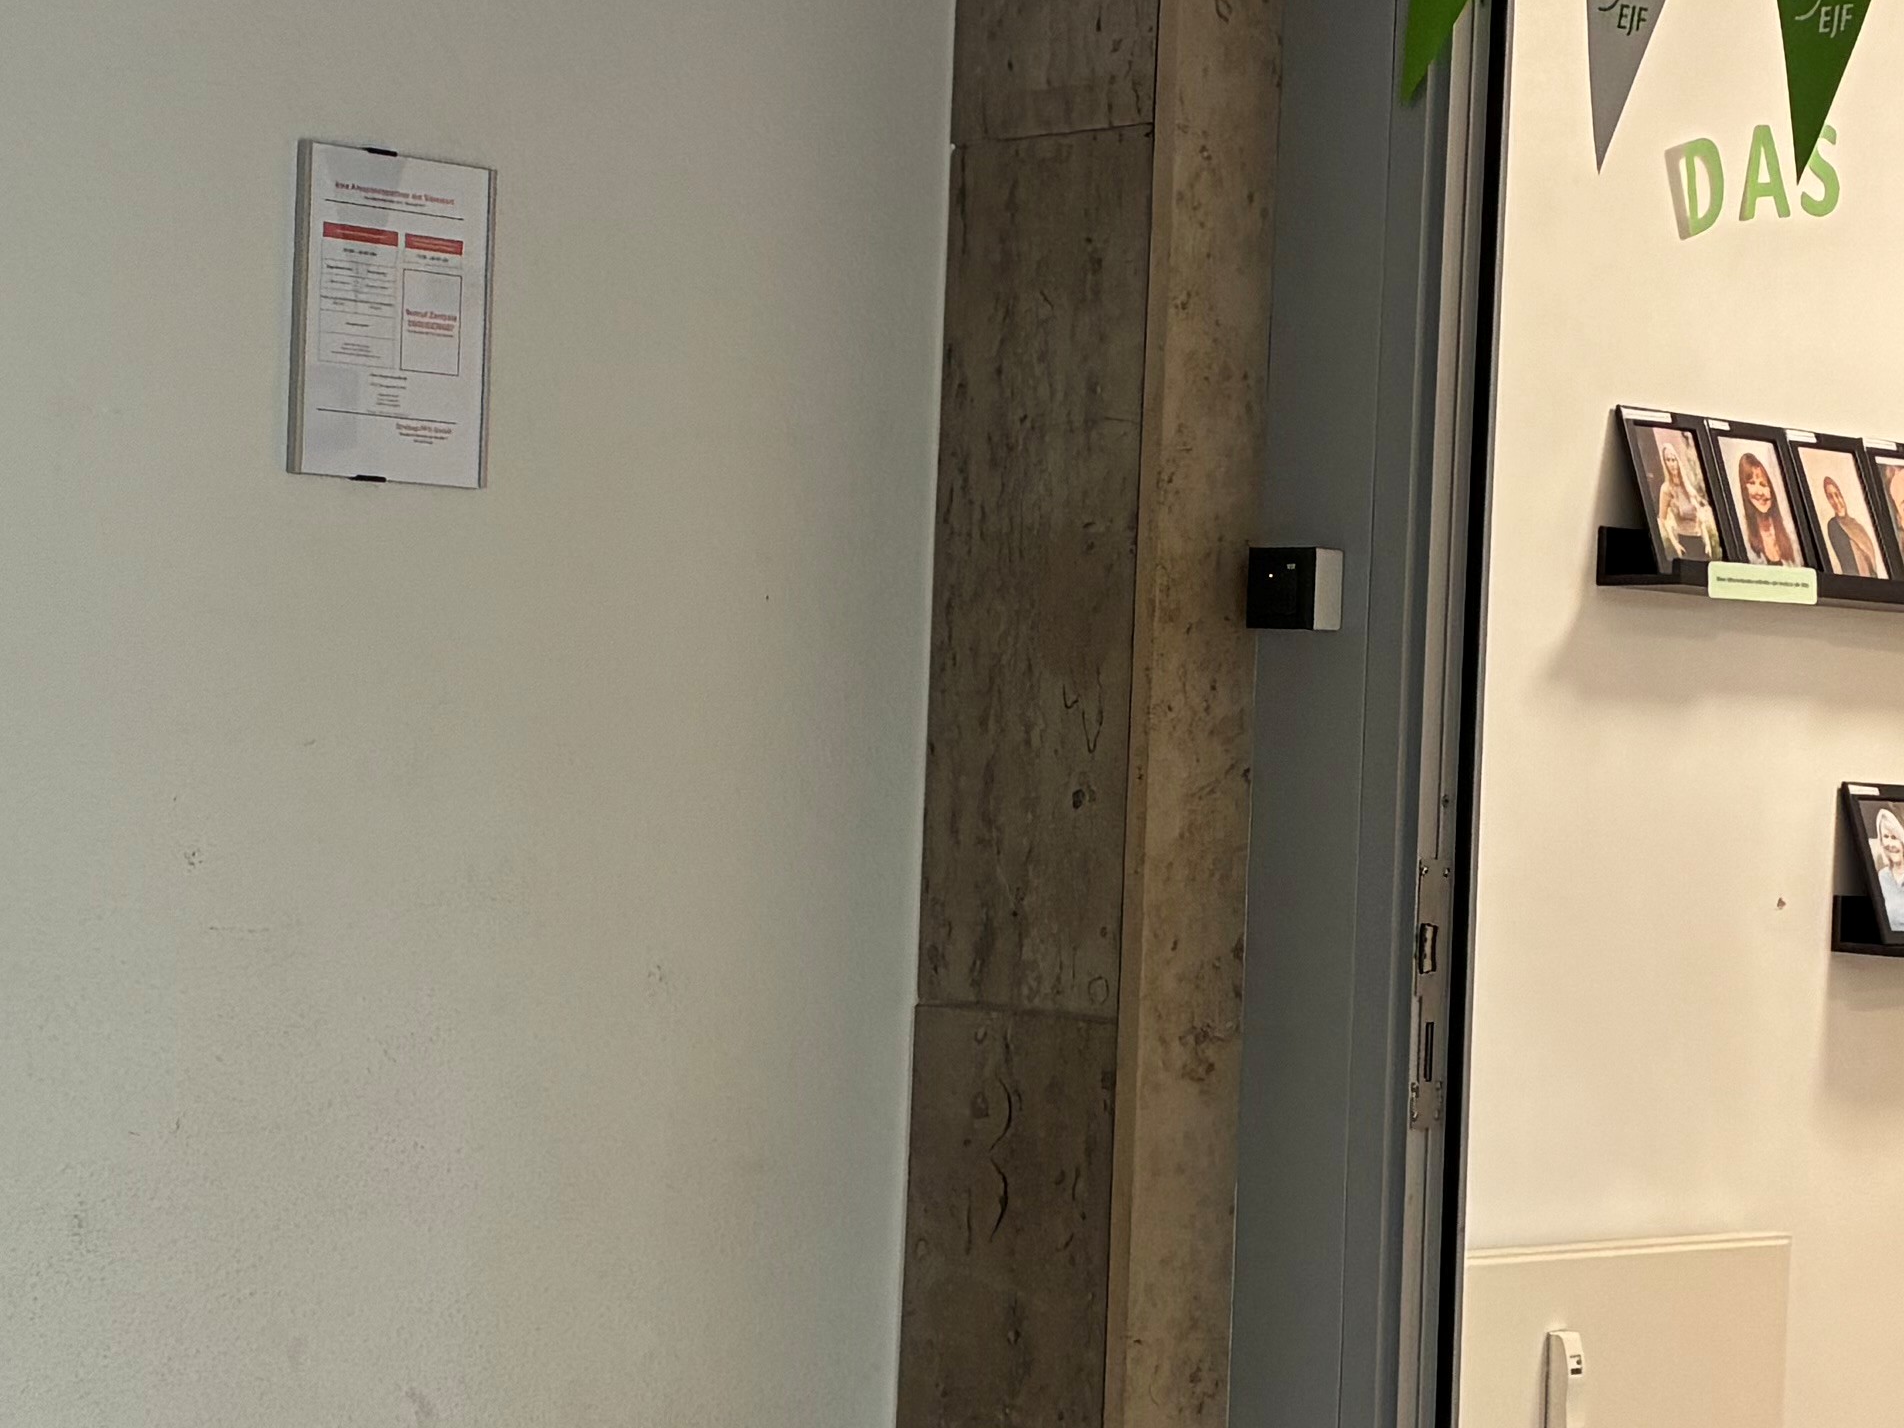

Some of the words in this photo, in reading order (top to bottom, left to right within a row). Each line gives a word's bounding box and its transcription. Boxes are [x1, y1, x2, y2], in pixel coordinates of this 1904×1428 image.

[1616, 3, 1649, 37] EJF
[1818, 3, 1854, 39] EJF
[1665, 124, 1841, 241] DAS
